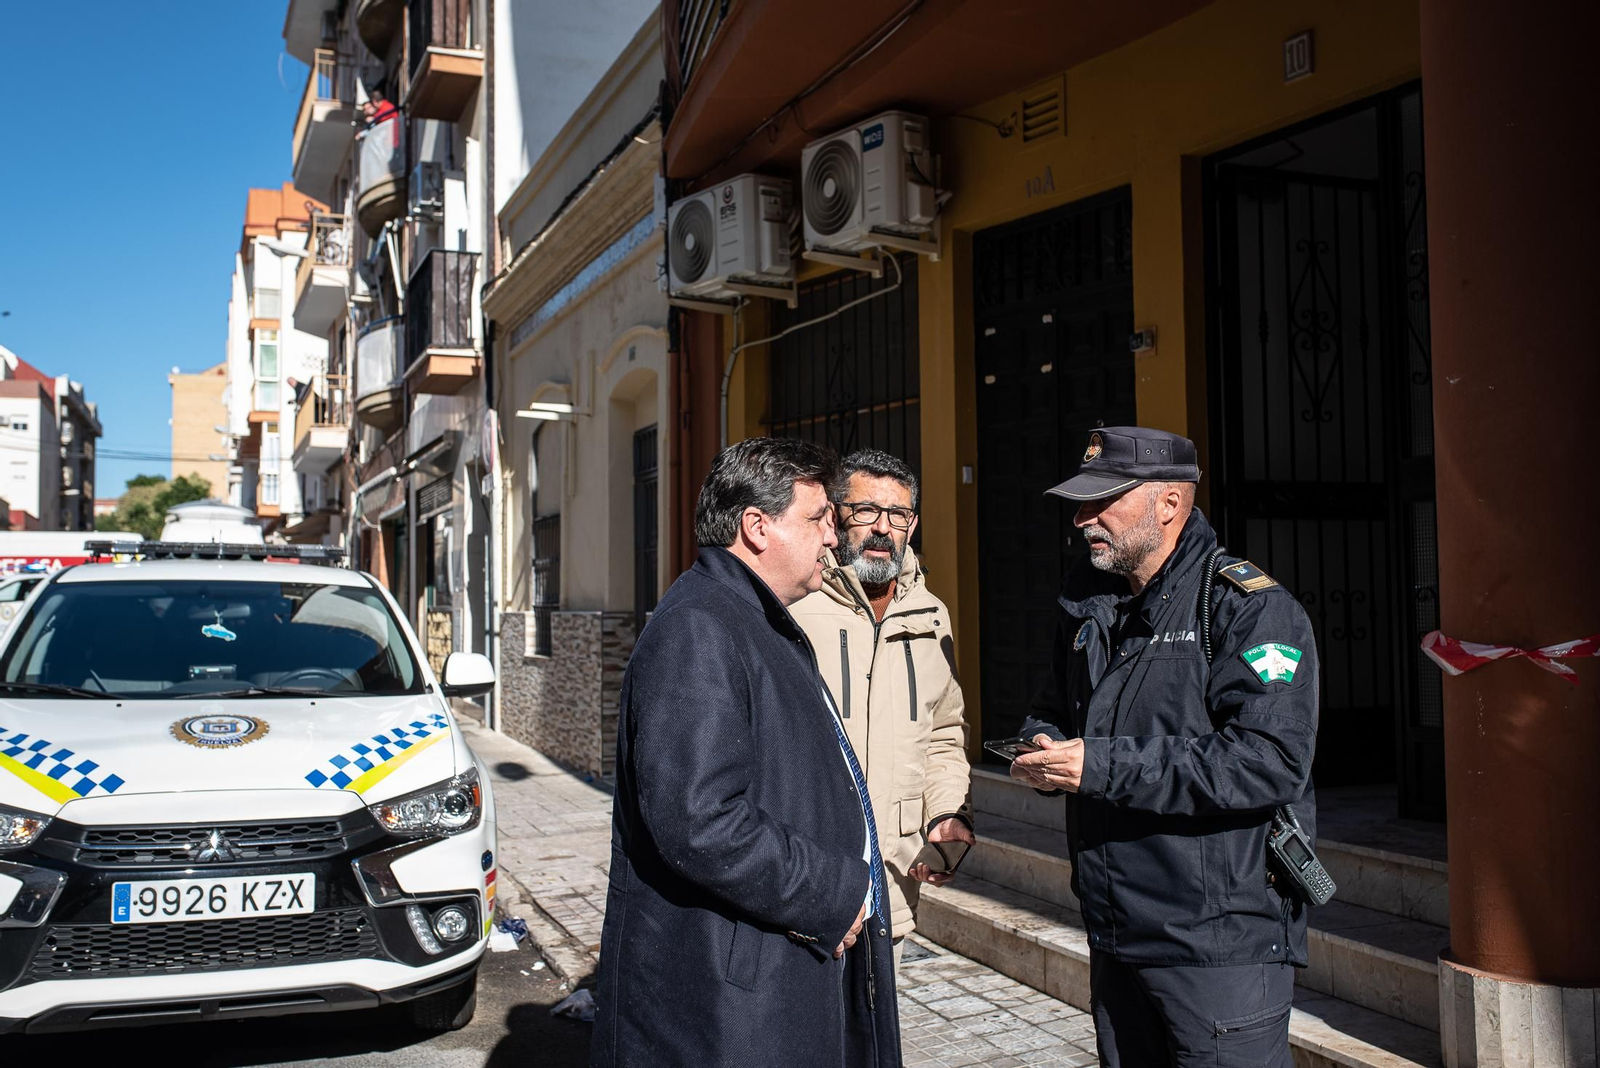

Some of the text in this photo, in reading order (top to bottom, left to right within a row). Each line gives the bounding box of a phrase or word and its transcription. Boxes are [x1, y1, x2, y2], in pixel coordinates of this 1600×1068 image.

[1288, 40, 1307, 75] 10
[1024, 165, 1055, 198] 10A
[1150, 630, 1196, 645] PLICIA
[118, 906, 127, 915] E
[138, 879, 305, 917] 9926 KZX
